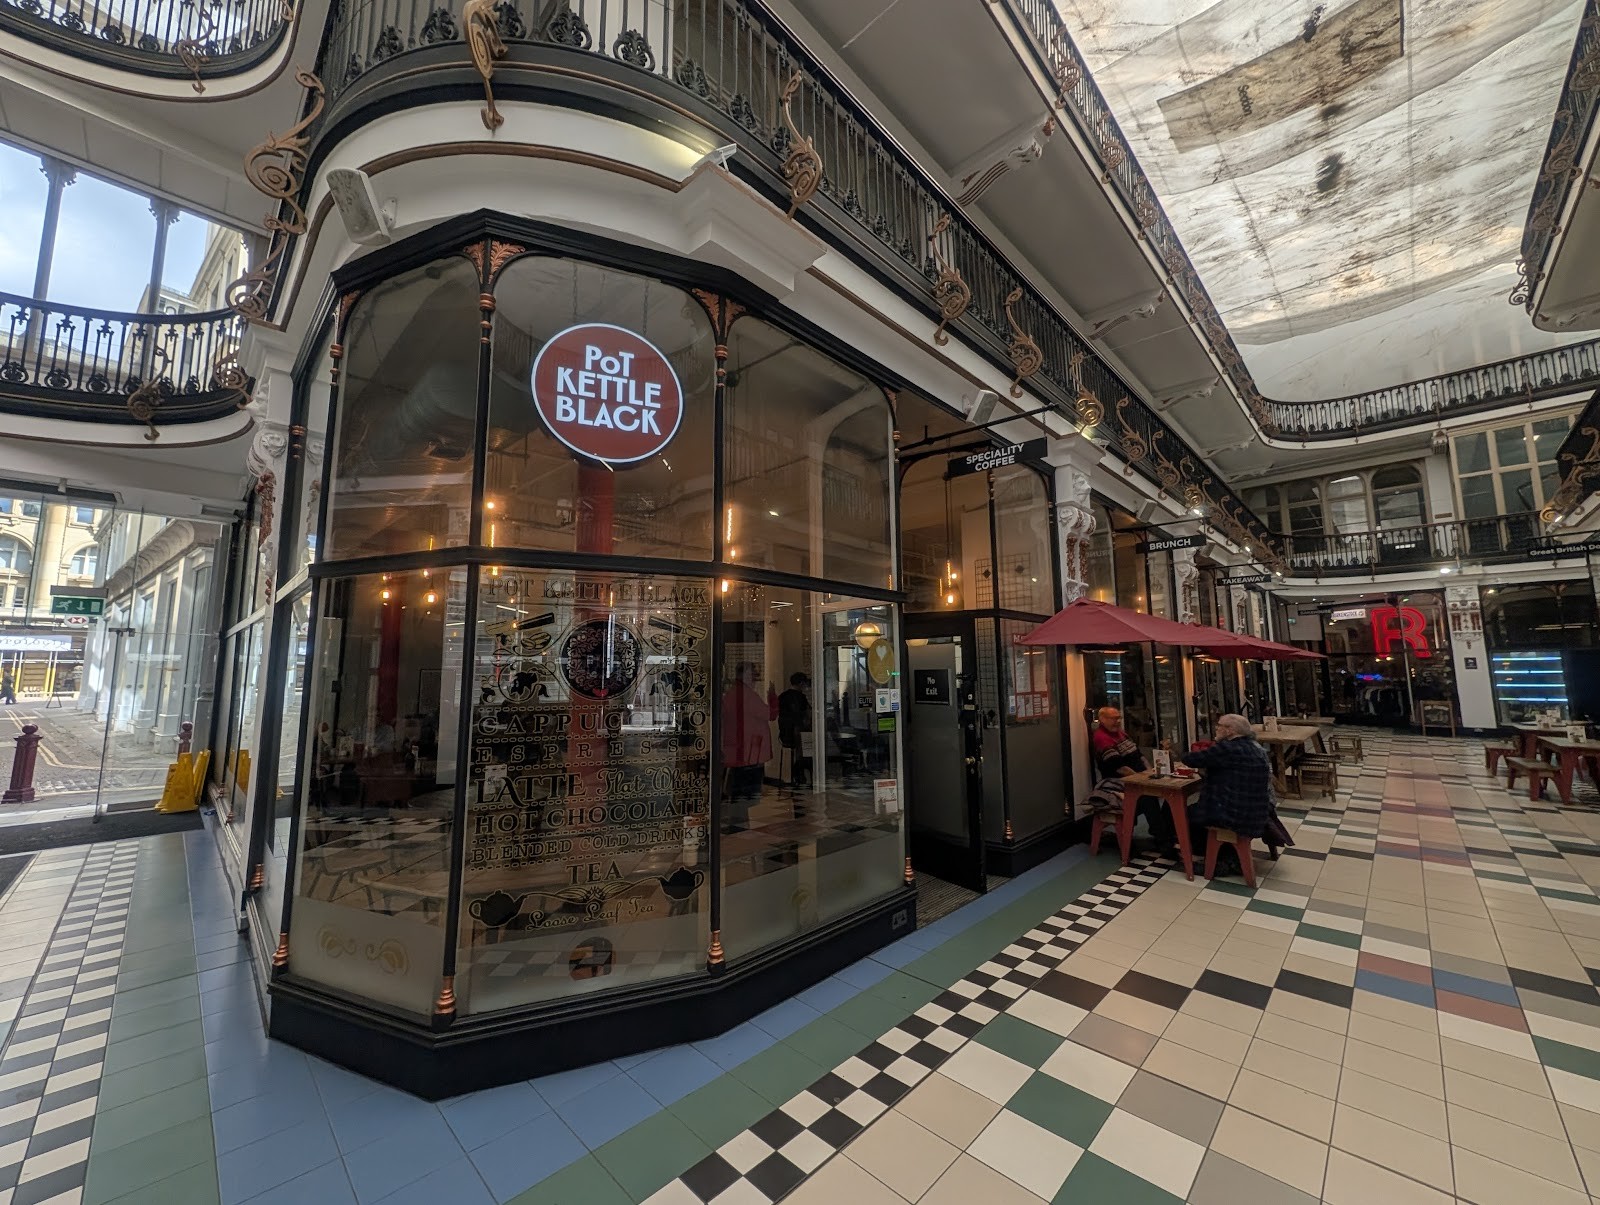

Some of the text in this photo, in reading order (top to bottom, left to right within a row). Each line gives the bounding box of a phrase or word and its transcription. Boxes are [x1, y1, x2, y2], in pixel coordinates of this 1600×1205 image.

[1237, 84, 1254, 117] Seddon
[556, 366, 662, 408] KETTLE
[556, 395, 662, 436] BLACK
[966, 443, 1025, 465] SPECIALITY
[974, 455, 1015, 472] COFFEE
[1149, 538, 1191, 551] BRUNCH
[1556, 545, 1587, 554] British
[486, 578, 535, 598] POT
[637, 584, 707, 604] BLACK
[1222, 575, 1265, 585] TAKEAWAY
[925, 687, 939, 696] Exit
[926, 676, 936, 685] No
[477, 710, 706, 736] CAPPUCCNO
[475, 737, 706, 765] ESPRESSO
[474, 766, 706, 809] LATTE Flat White
[473, 797, 706, 836] HOT CHOCOLATE
[470, 825, 706, 864] BLENDED COLD DRINKS
[565, 860, 624, 885] TEA
[525, 896, 656, 931] Loose Leaf Tea
